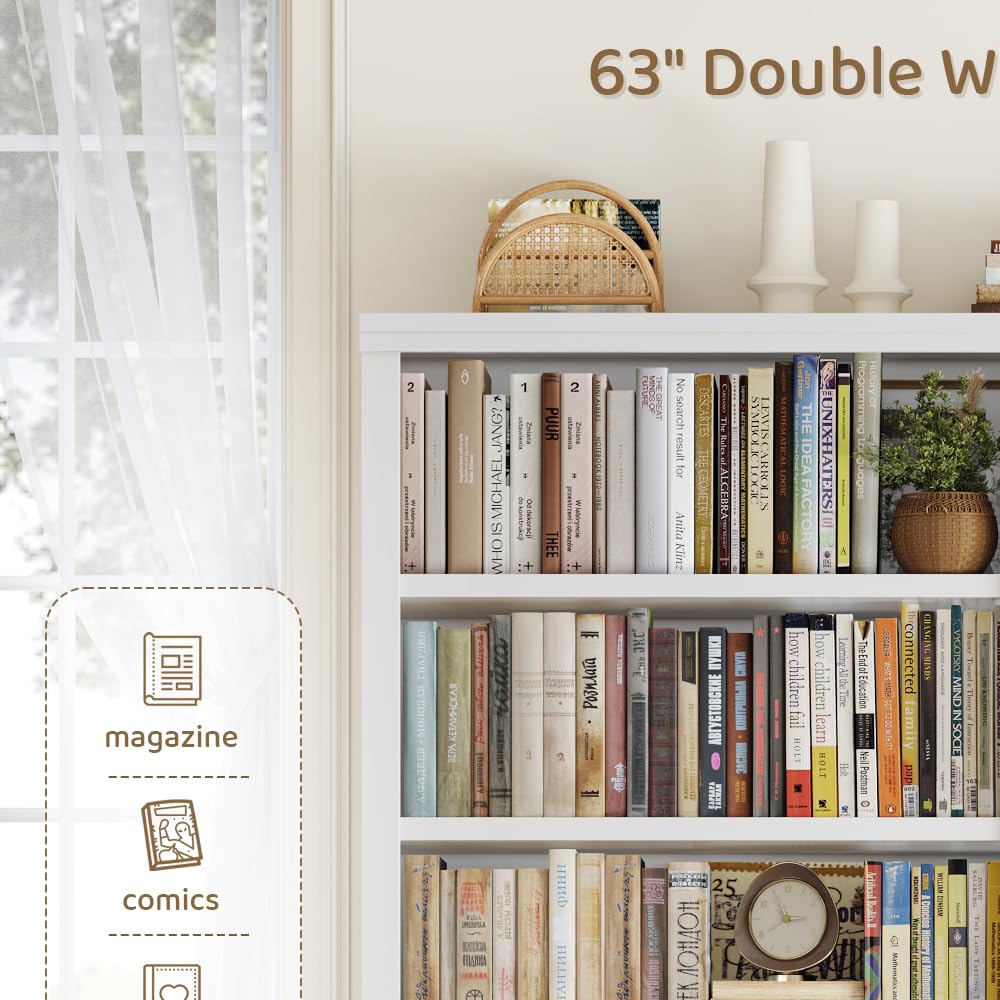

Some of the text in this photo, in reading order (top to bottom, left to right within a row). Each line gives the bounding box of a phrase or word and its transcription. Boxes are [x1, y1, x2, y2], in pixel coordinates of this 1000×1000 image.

[407, 382, 414, 392] 2
[522, 383, 528, 392] 1
[571, 382, 579, 392] 2
[699, 388, 709, 437] DESCARTES
[546, 407, 559, 440] PUUR
[676, 378, 685, 478] No search result for
[761, 397, 769, 439] LEWIS
[751, 396, 759, 504] SYMBOLIC LOGIC
[491, 408, 502, 574] WHO IS MICHAEL JANG?
[698, 450, 709, 517] THE GEOMETRY
[801, 403, 812, 552] THE IDEA FACTORY
[546, 532, 558, 557] THEE
[675, 512, 685, 570] Anita Klinz
[858, 642, 868, 653] The
[859, 655, 868, 666] End
[582, 658, 598, 709] Розплата
[708, 636, 721, 745] АВГУСТОВСКИЕ ПУШКИ
[789, 632, 804, 728] how children fail
[815, 634, 830, 743] how children learn
[859, 676, 868, 708] Education
[904, 624, 916, 749] connected family
[953, 630, 961, 720] VYGOTSKY MIND IN
[449, 683, 458, 741] КЕТЛИНСКАЯ
[860, 752, 869, 794] Neil Postman
[557, 864, 568, 907] ФИНН
[677, 901, 700, 977] ЛОНДОН
